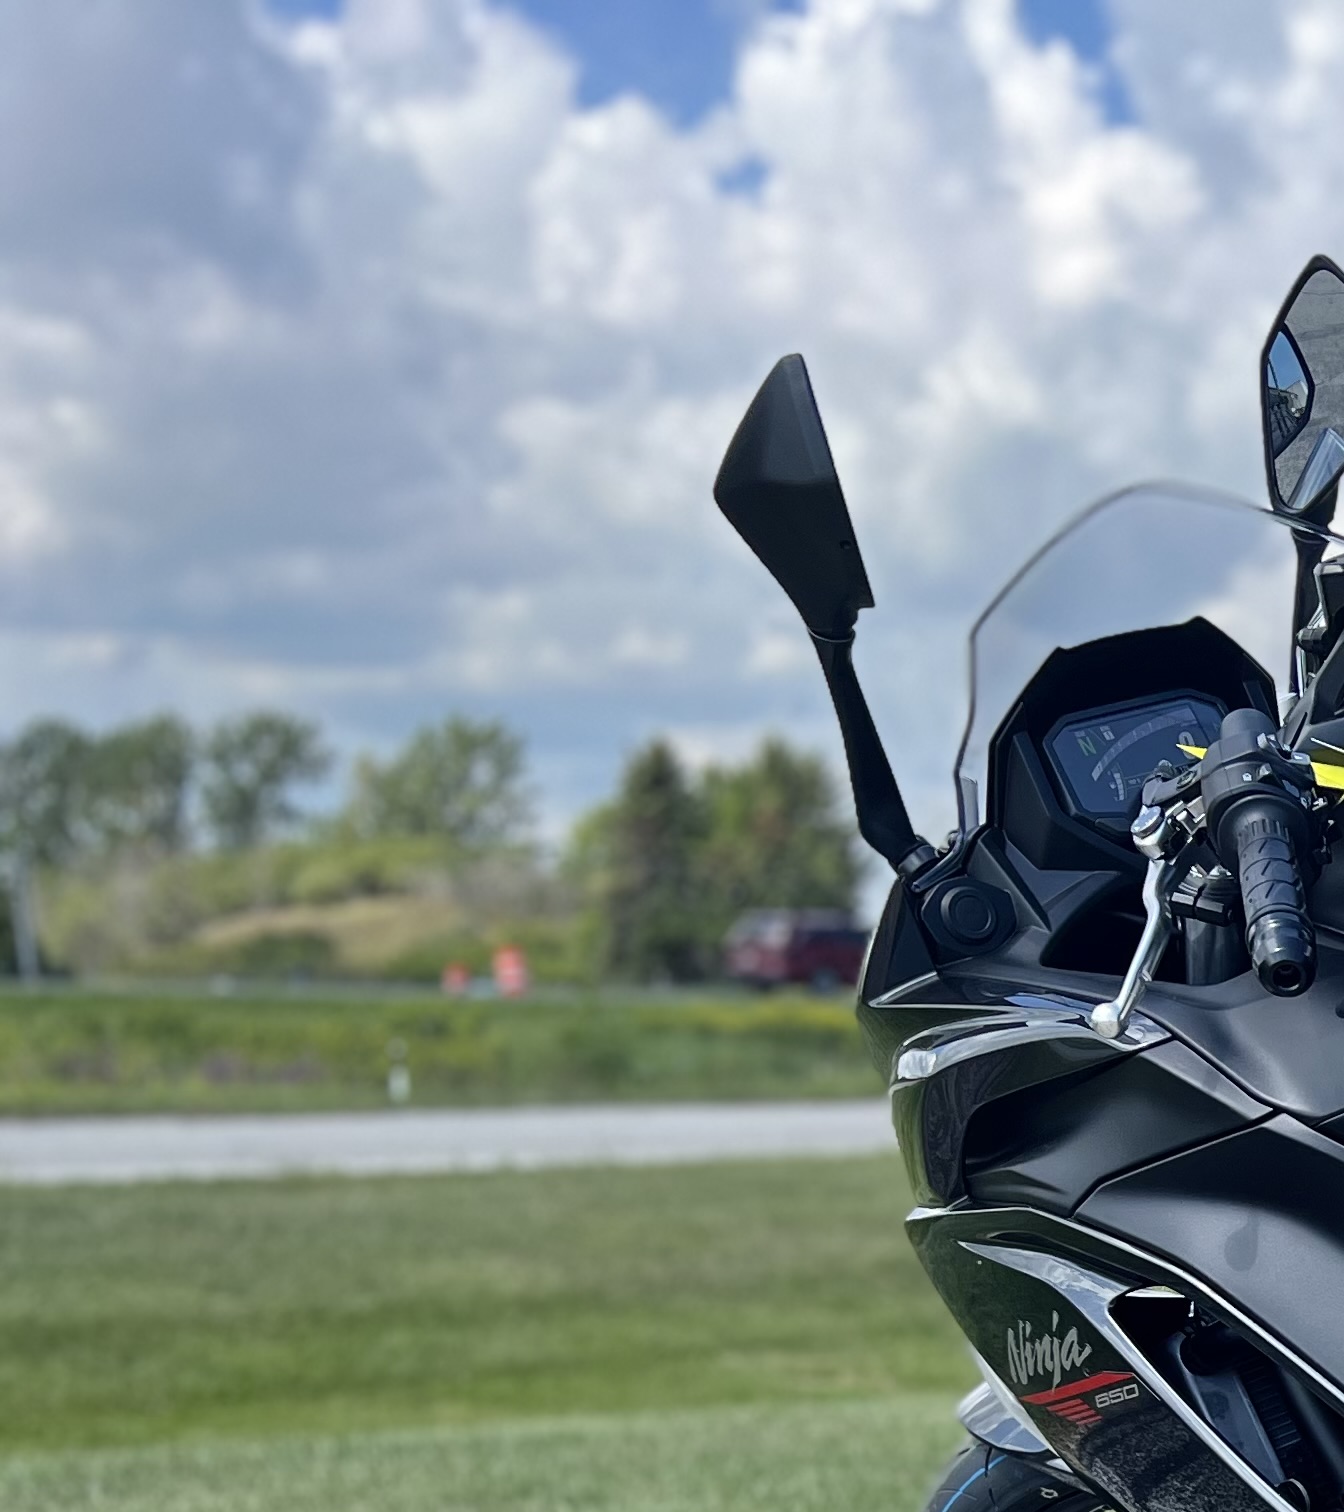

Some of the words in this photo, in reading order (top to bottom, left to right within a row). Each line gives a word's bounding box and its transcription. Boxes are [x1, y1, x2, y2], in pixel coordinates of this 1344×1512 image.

[1077, 736, 1097, 756] N
[1008, 1311, 1091, 1389] Ninja
[1095, 1384, 1139, 1408] 650
